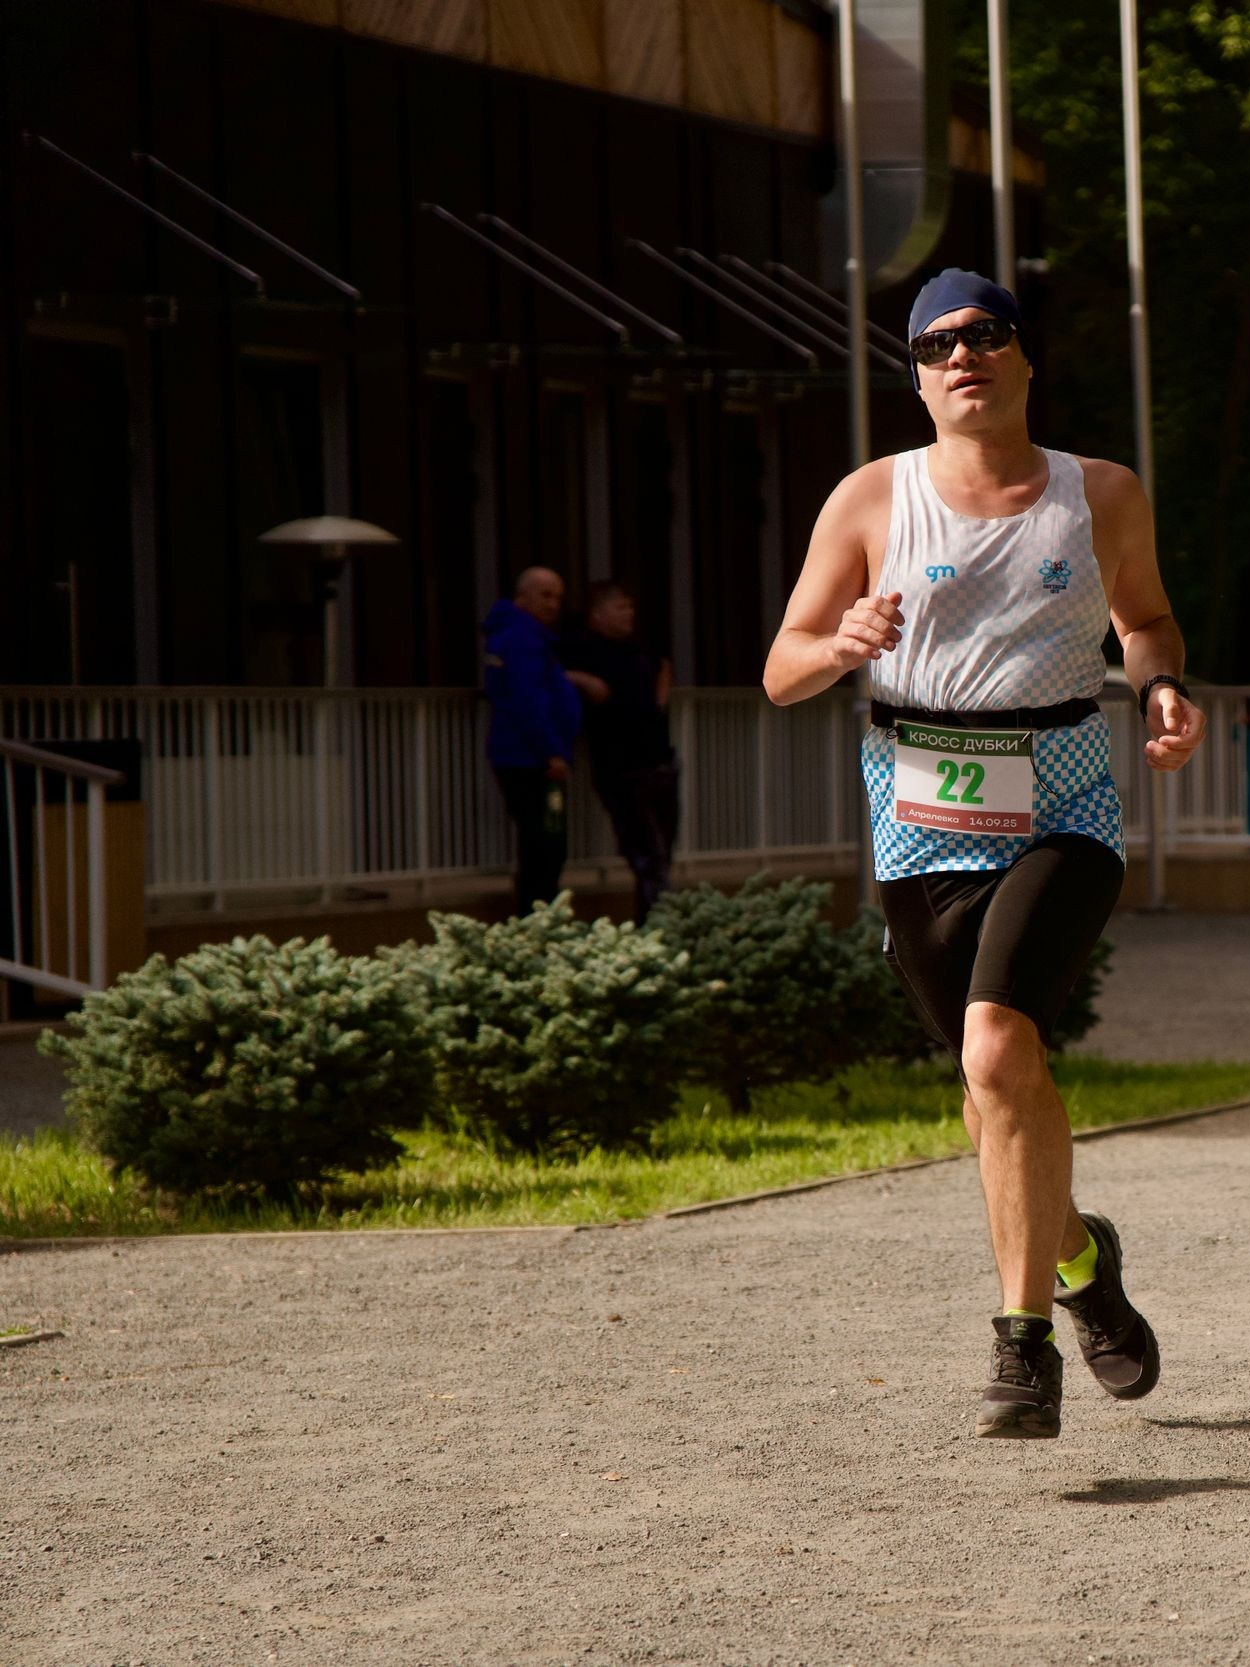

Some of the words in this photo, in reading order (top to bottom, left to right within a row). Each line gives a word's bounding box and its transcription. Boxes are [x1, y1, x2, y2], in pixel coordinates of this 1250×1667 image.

[925, 565, 956, 583] gm
[909, 731, 960, 748] КРОСС
[963, 738, 1018, 752] ДУБКИ
[936, 759, 985, 805] 22
[908, 808, 960, 824] Апрелевка
[969, 817, 1018, 828] 14.09.25
